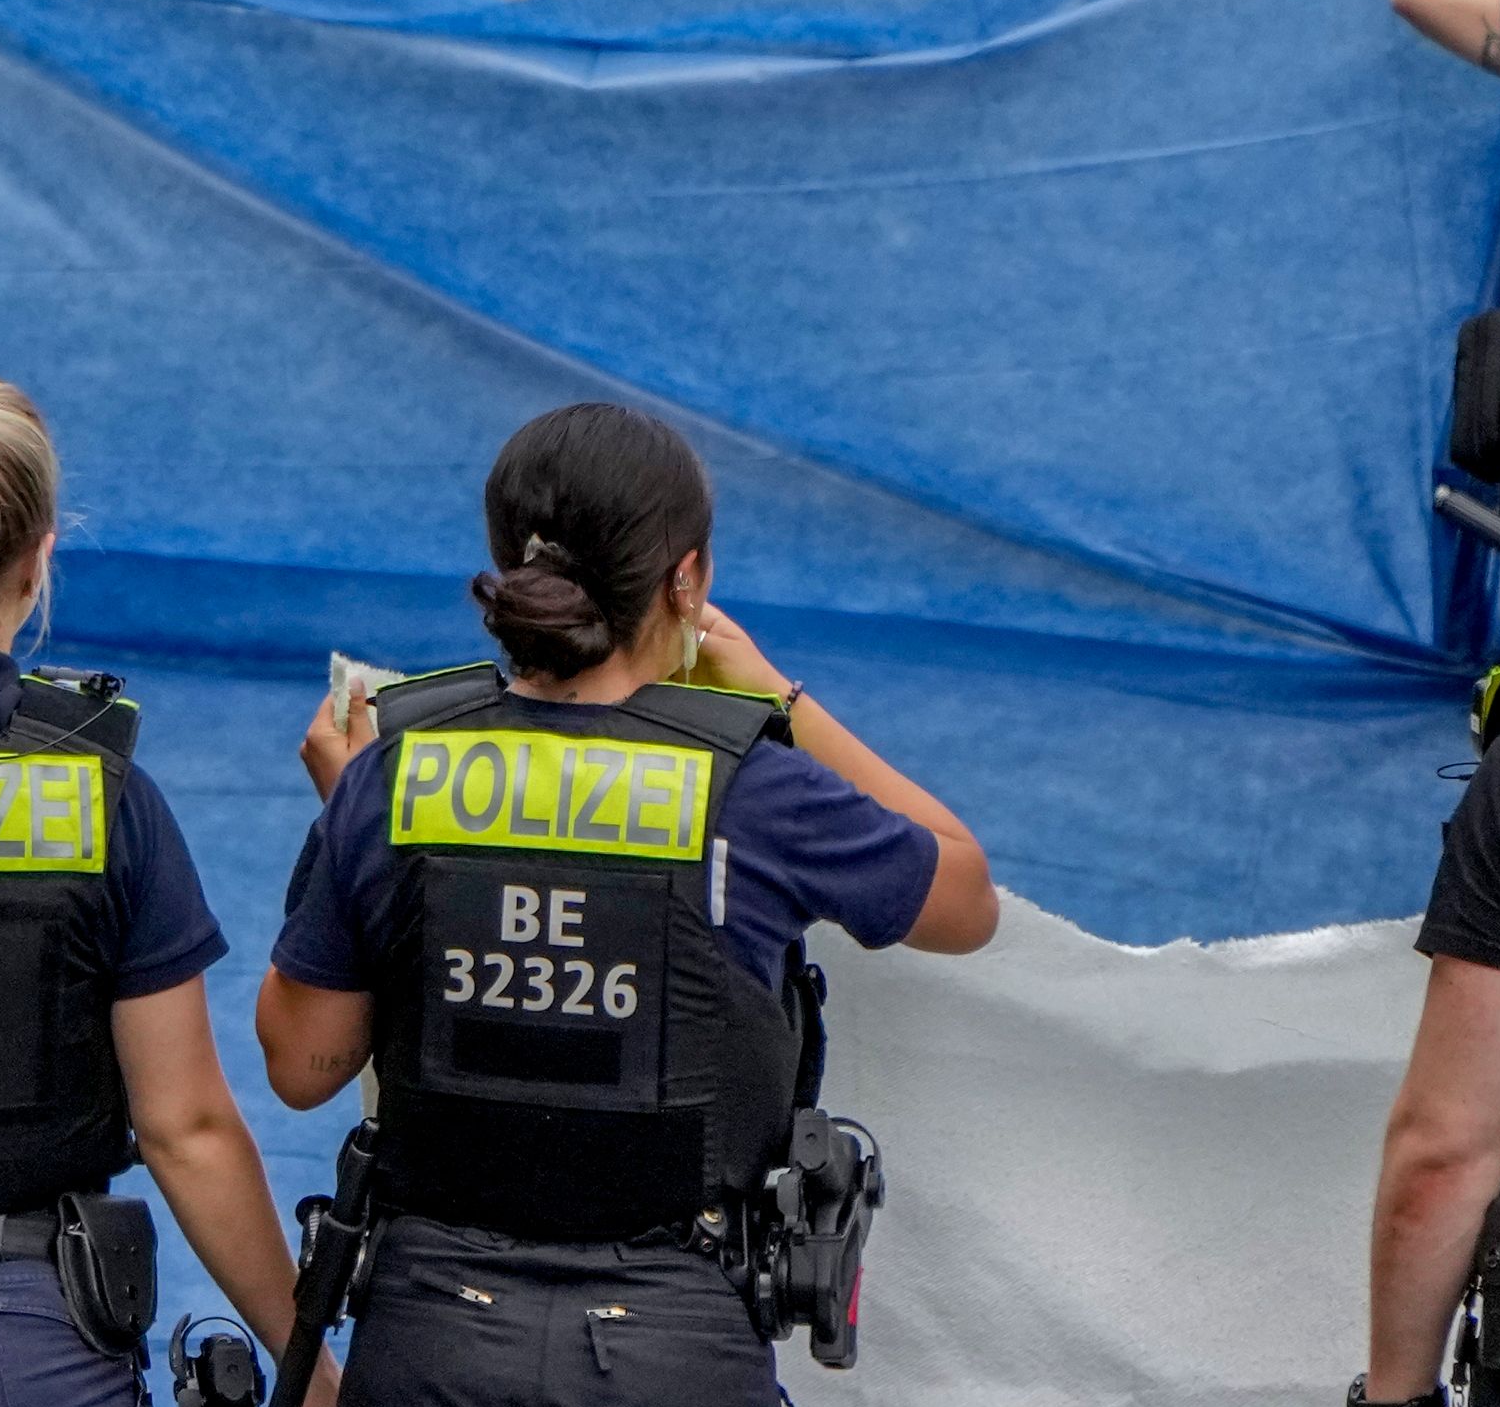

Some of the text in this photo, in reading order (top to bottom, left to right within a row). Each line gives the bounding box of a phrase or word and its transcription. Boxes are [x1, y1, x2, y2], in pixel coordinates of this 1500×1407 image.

[402, 740, 700, 848] POLIZEI
[500, 885, 588, 948] BE
[444, 948, 640, 1020] 32326
